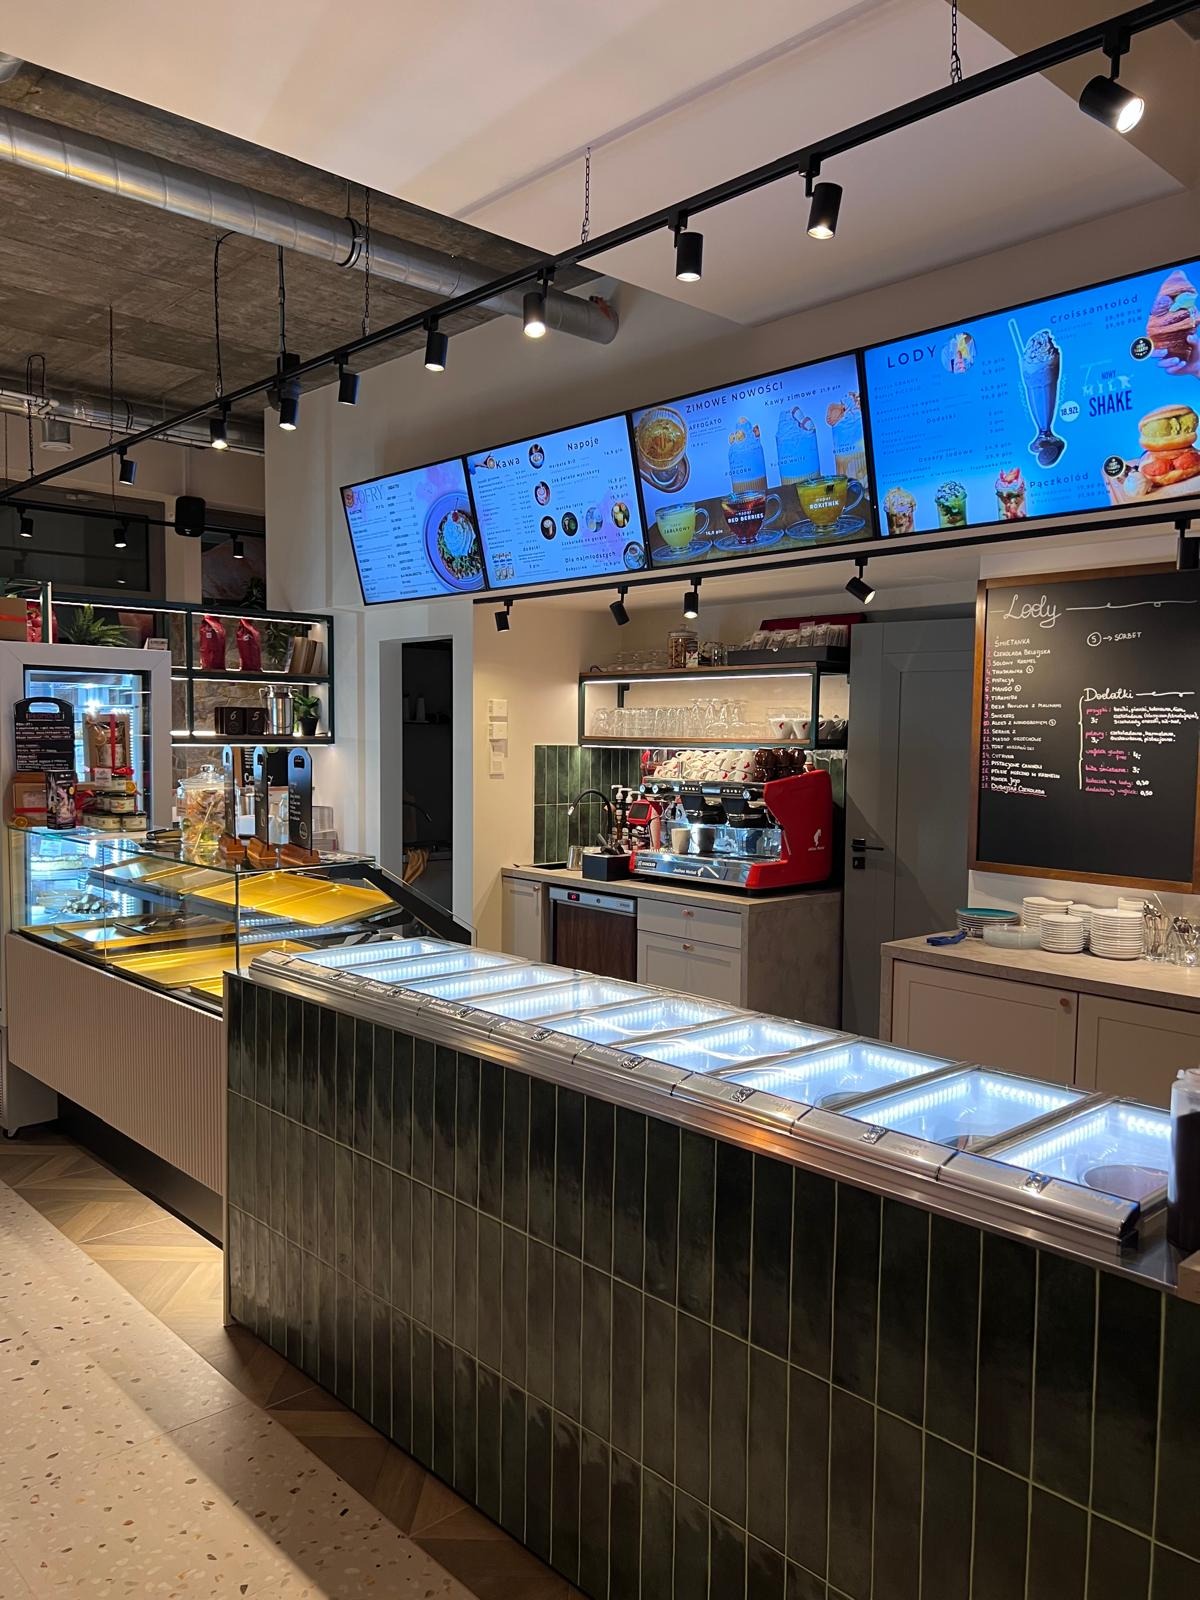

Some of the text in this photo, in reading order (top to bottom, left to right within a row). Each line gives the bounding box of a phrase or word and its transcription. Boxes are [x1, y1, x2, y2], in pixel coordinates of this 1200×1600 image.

[887, 345, 937, 369] LODY
[1101, 370, 1117, 379] NOWY
[686, 381, 783, 414] ZIMOWE NOWOŚCI
[764, 398, 784, 407] Kawy
[787, 389, 816, 401] zimowe
[1089, 390, 1133, 418] SHAKE
[689, 418, 722, 431] AFFOGATO
[567, 437, 599, 451] Napoje
[496, 457, 520, 469] Kawa
[809, 500, 840, 510] ROKITNIK
[740, 513, 764, 522] BERRIES
[1003, 594, 1062, 628] Lody
[1114, 632, 1143, 642] SORBET
[1083, 687, 1134, 702] Dodatki
[230, 710, 260, 720] 6 5
